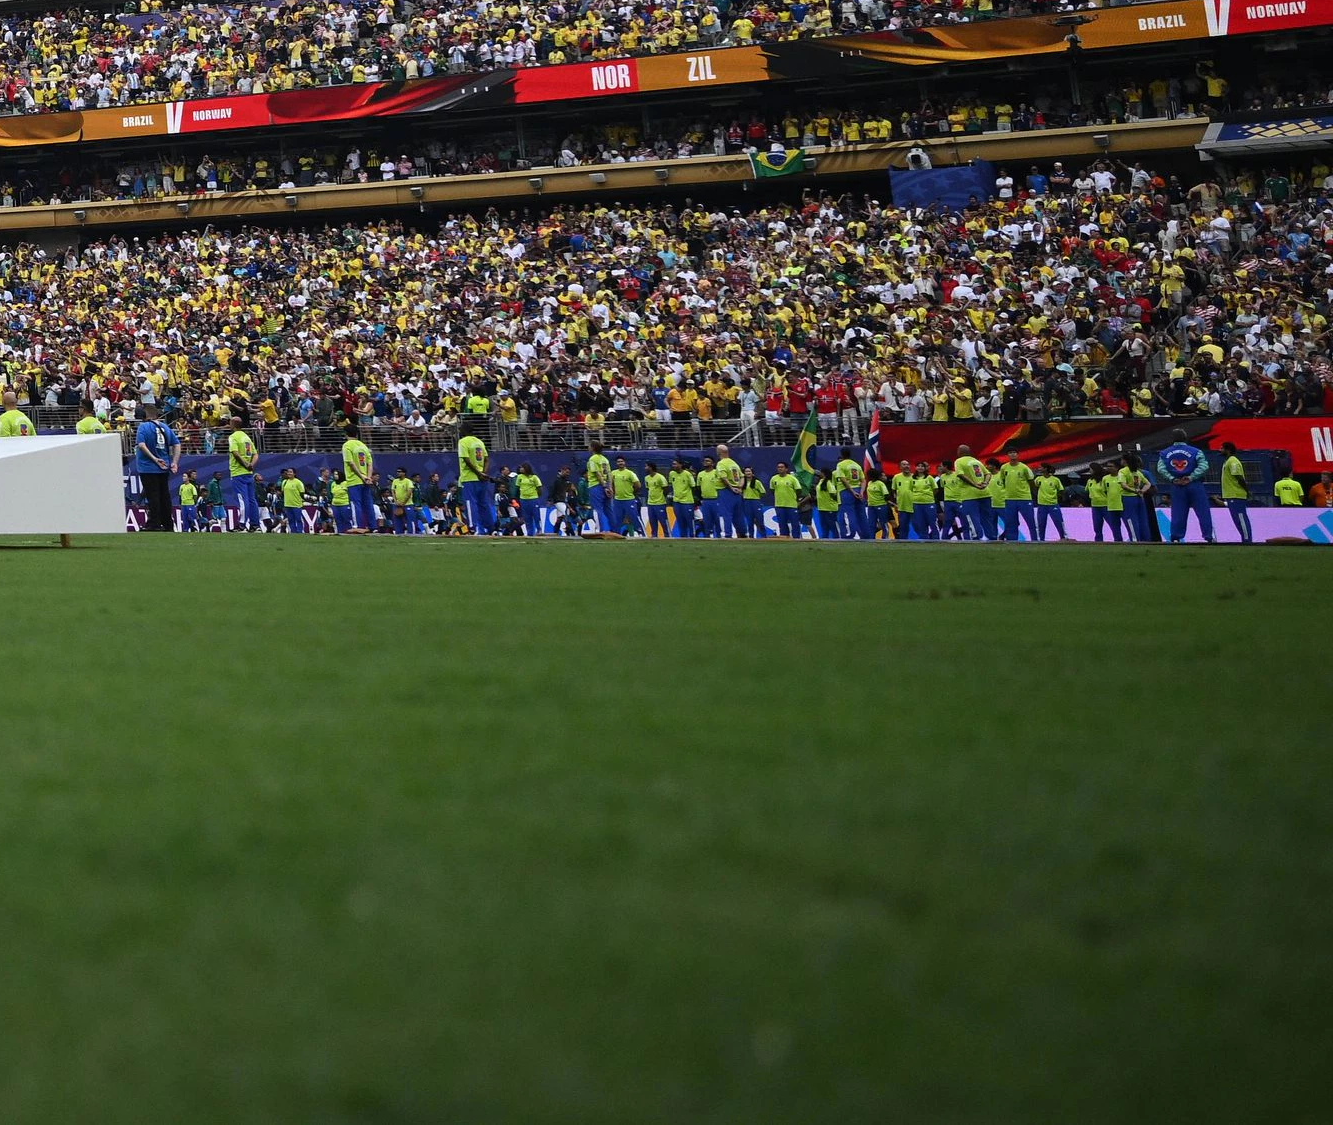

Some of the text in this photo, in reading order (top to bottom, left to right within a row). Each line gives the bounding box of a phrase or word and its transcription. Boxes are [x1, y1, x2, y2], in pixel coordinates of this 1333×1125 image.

[1137, 14, 1186, 31] BRAZIL
[1246, 1, 1307, 20] NORWAY
[591, 64, 631, 91] NOR
[686, 56, 716, 82] ZIL
[122, 101, 232, 134] BRAZIL V NORWAY
